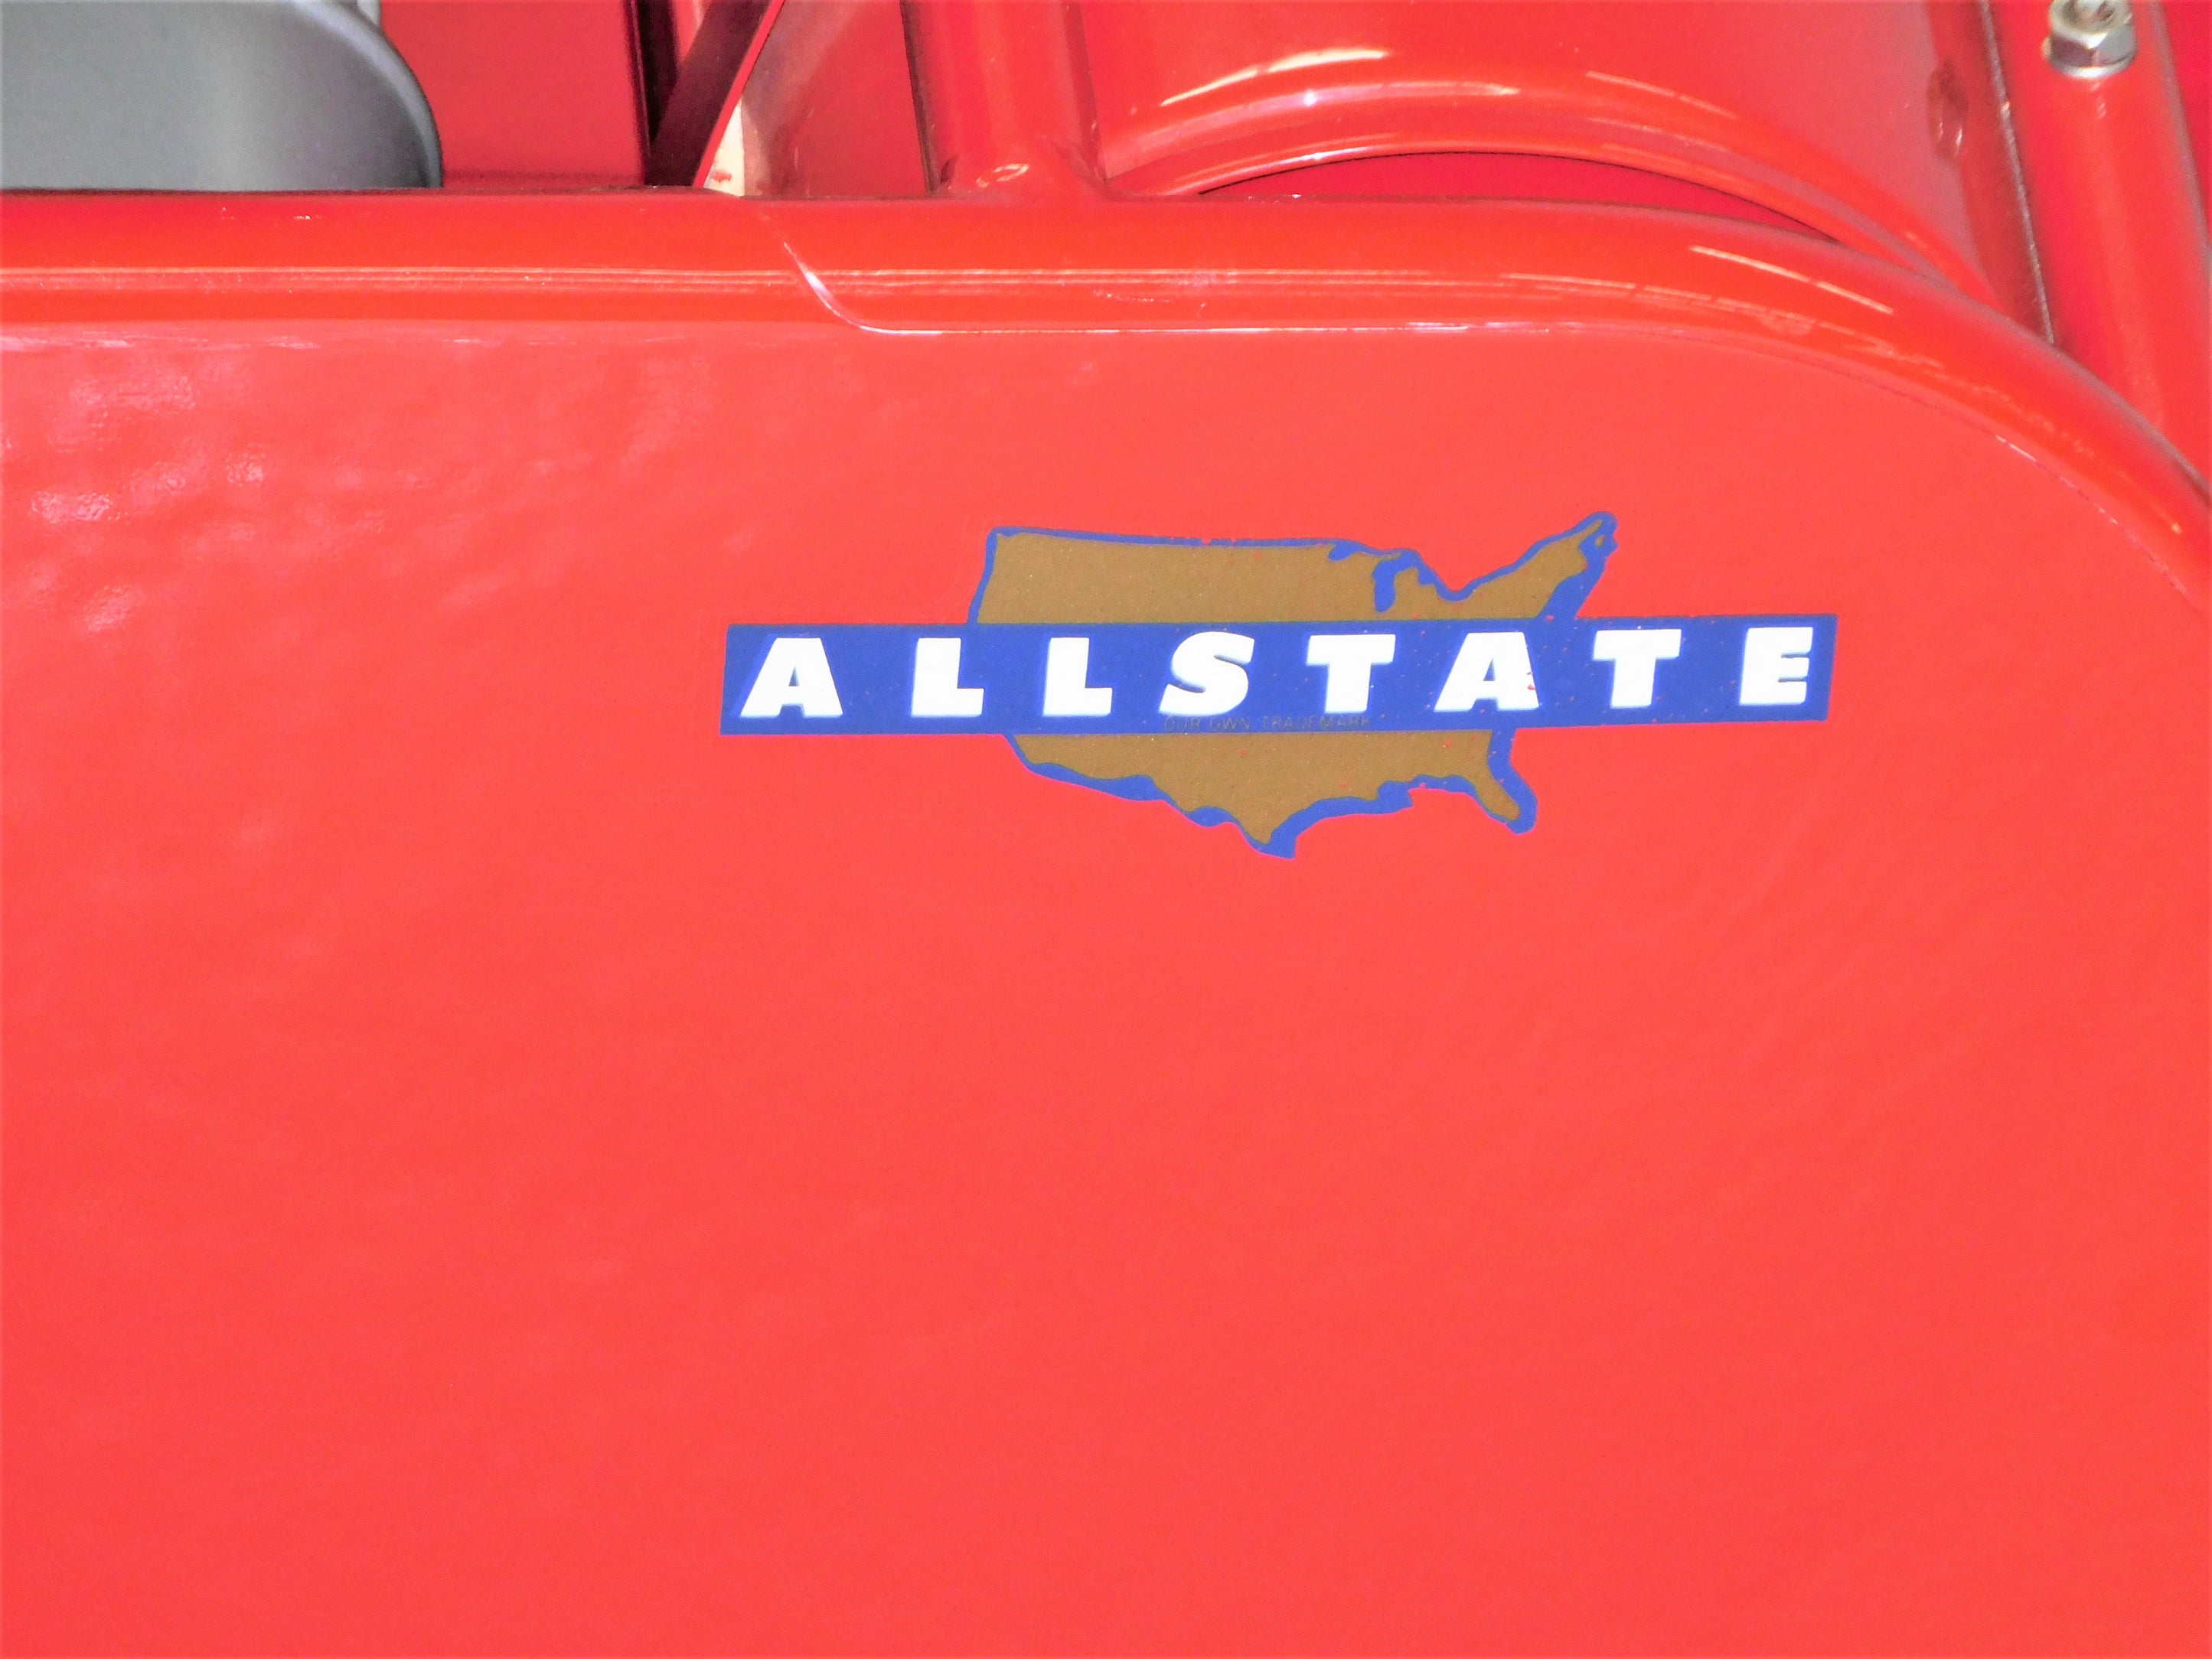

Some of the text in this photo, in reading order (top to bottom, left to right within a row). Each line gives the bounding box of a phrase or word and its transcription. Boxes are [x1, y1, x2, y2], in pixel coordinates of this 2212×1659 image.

[739, 625, 1815, 719] ALLSTATE
[1163, 715, 1201, 731] OUR
[1209, 715, 1251, 730] OWN
